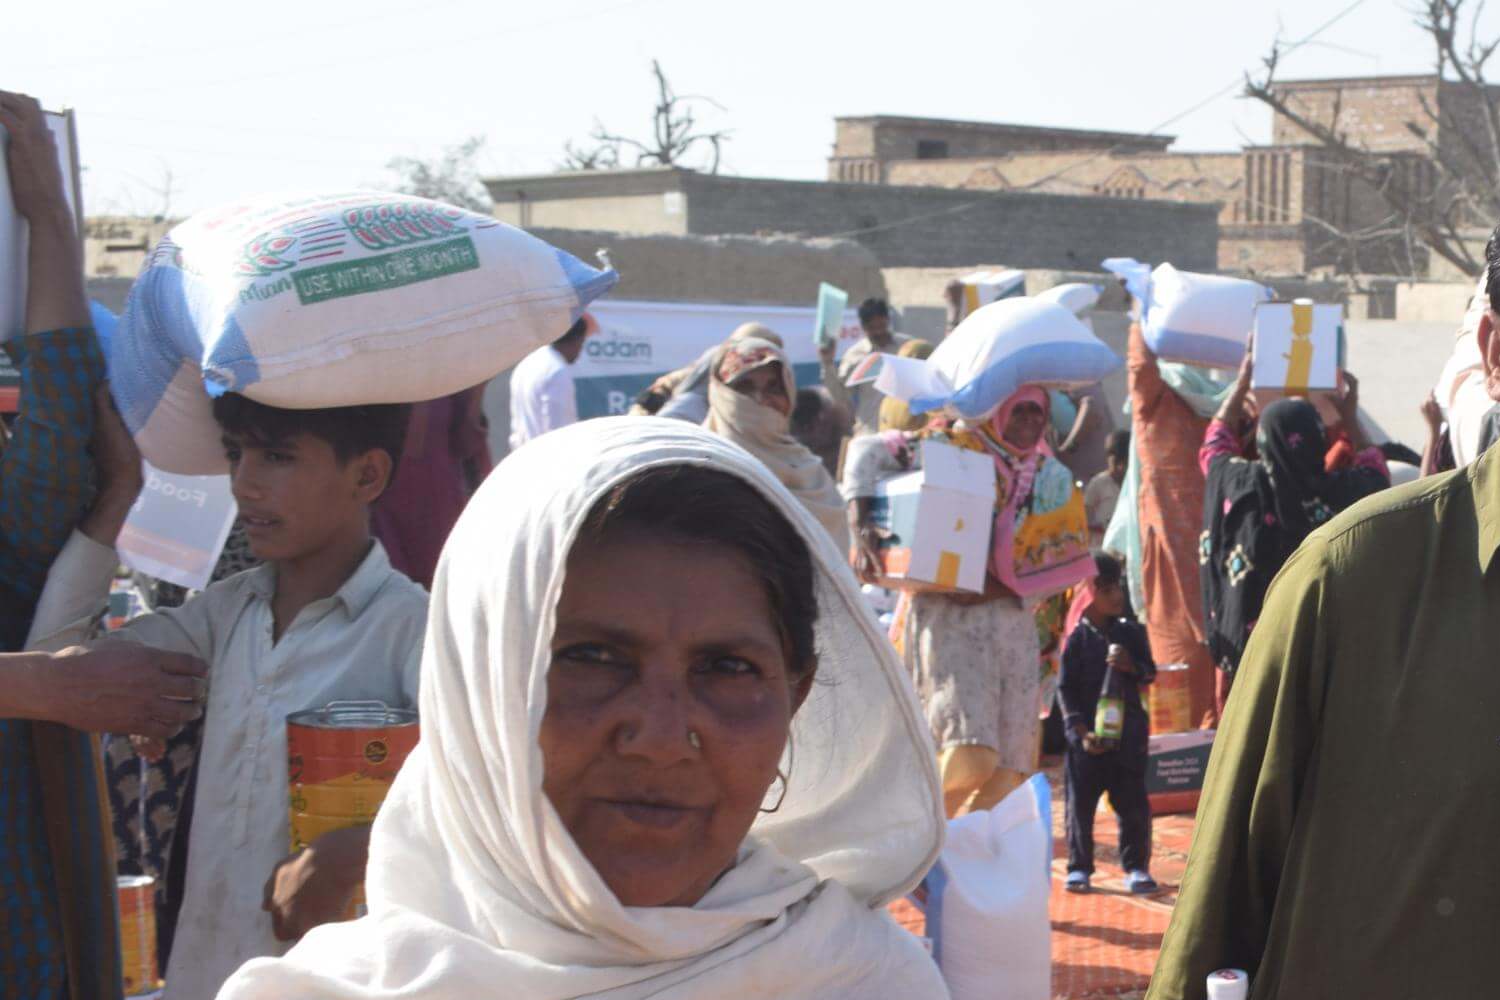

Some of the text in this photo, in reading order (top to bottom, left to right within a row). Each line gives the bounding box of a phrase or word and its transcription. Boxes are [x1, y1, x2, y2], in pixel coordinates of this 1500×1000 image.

[301, 274, 335, 297] USE
[418, 247, 472, 273] MONTH
[586, 338, 652, 358] adam
